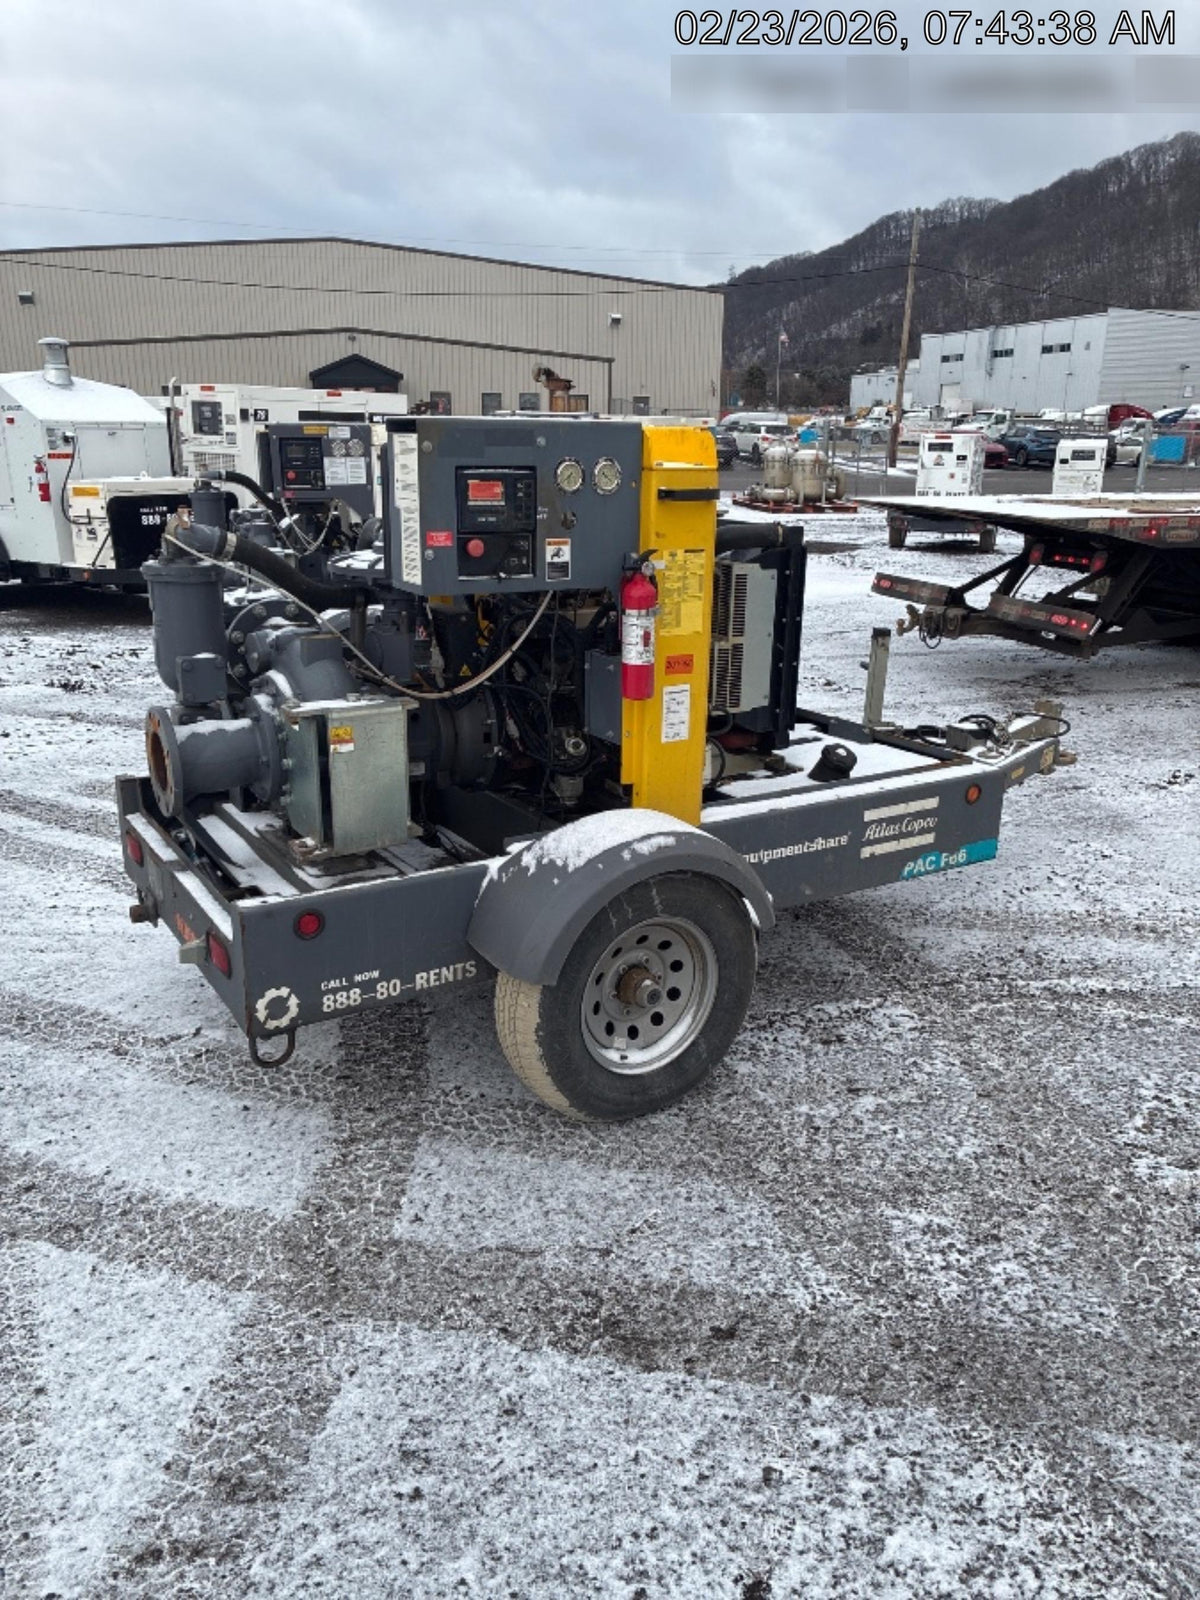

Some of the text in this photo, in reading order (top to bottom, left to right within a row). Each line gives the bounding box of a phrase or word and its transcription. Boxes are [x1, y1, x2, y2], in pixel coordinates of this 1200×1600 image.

[861, 816, 938, 842] Atlas Copco
[903, 855, 937, 877] PAC
[320, 969, 381, 991] CALL NOW
